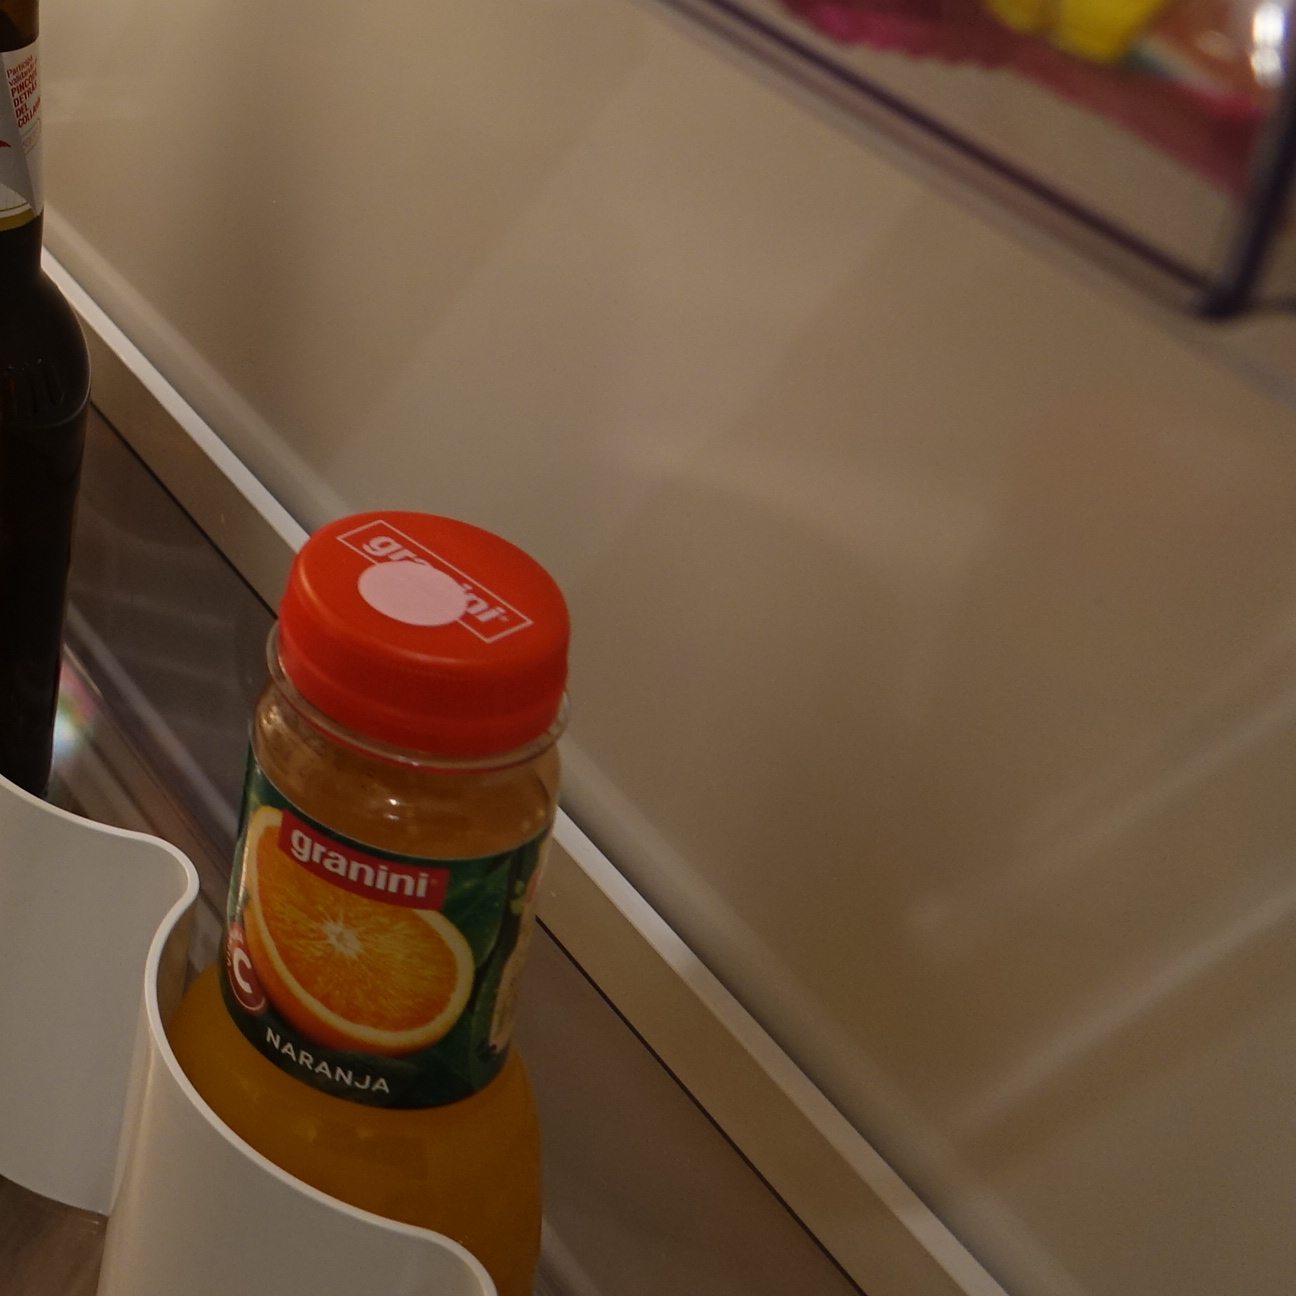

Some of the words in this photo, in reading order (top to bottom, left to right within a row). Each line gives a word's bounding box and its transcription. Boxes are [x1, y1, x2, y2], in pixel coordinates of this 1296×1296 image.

[15, 103, 30, 119] DEL
[289, 825, 432, 900] granini
[232, 946, 254, 995] C
[265, 1024, 391, 1095] NARANJA
